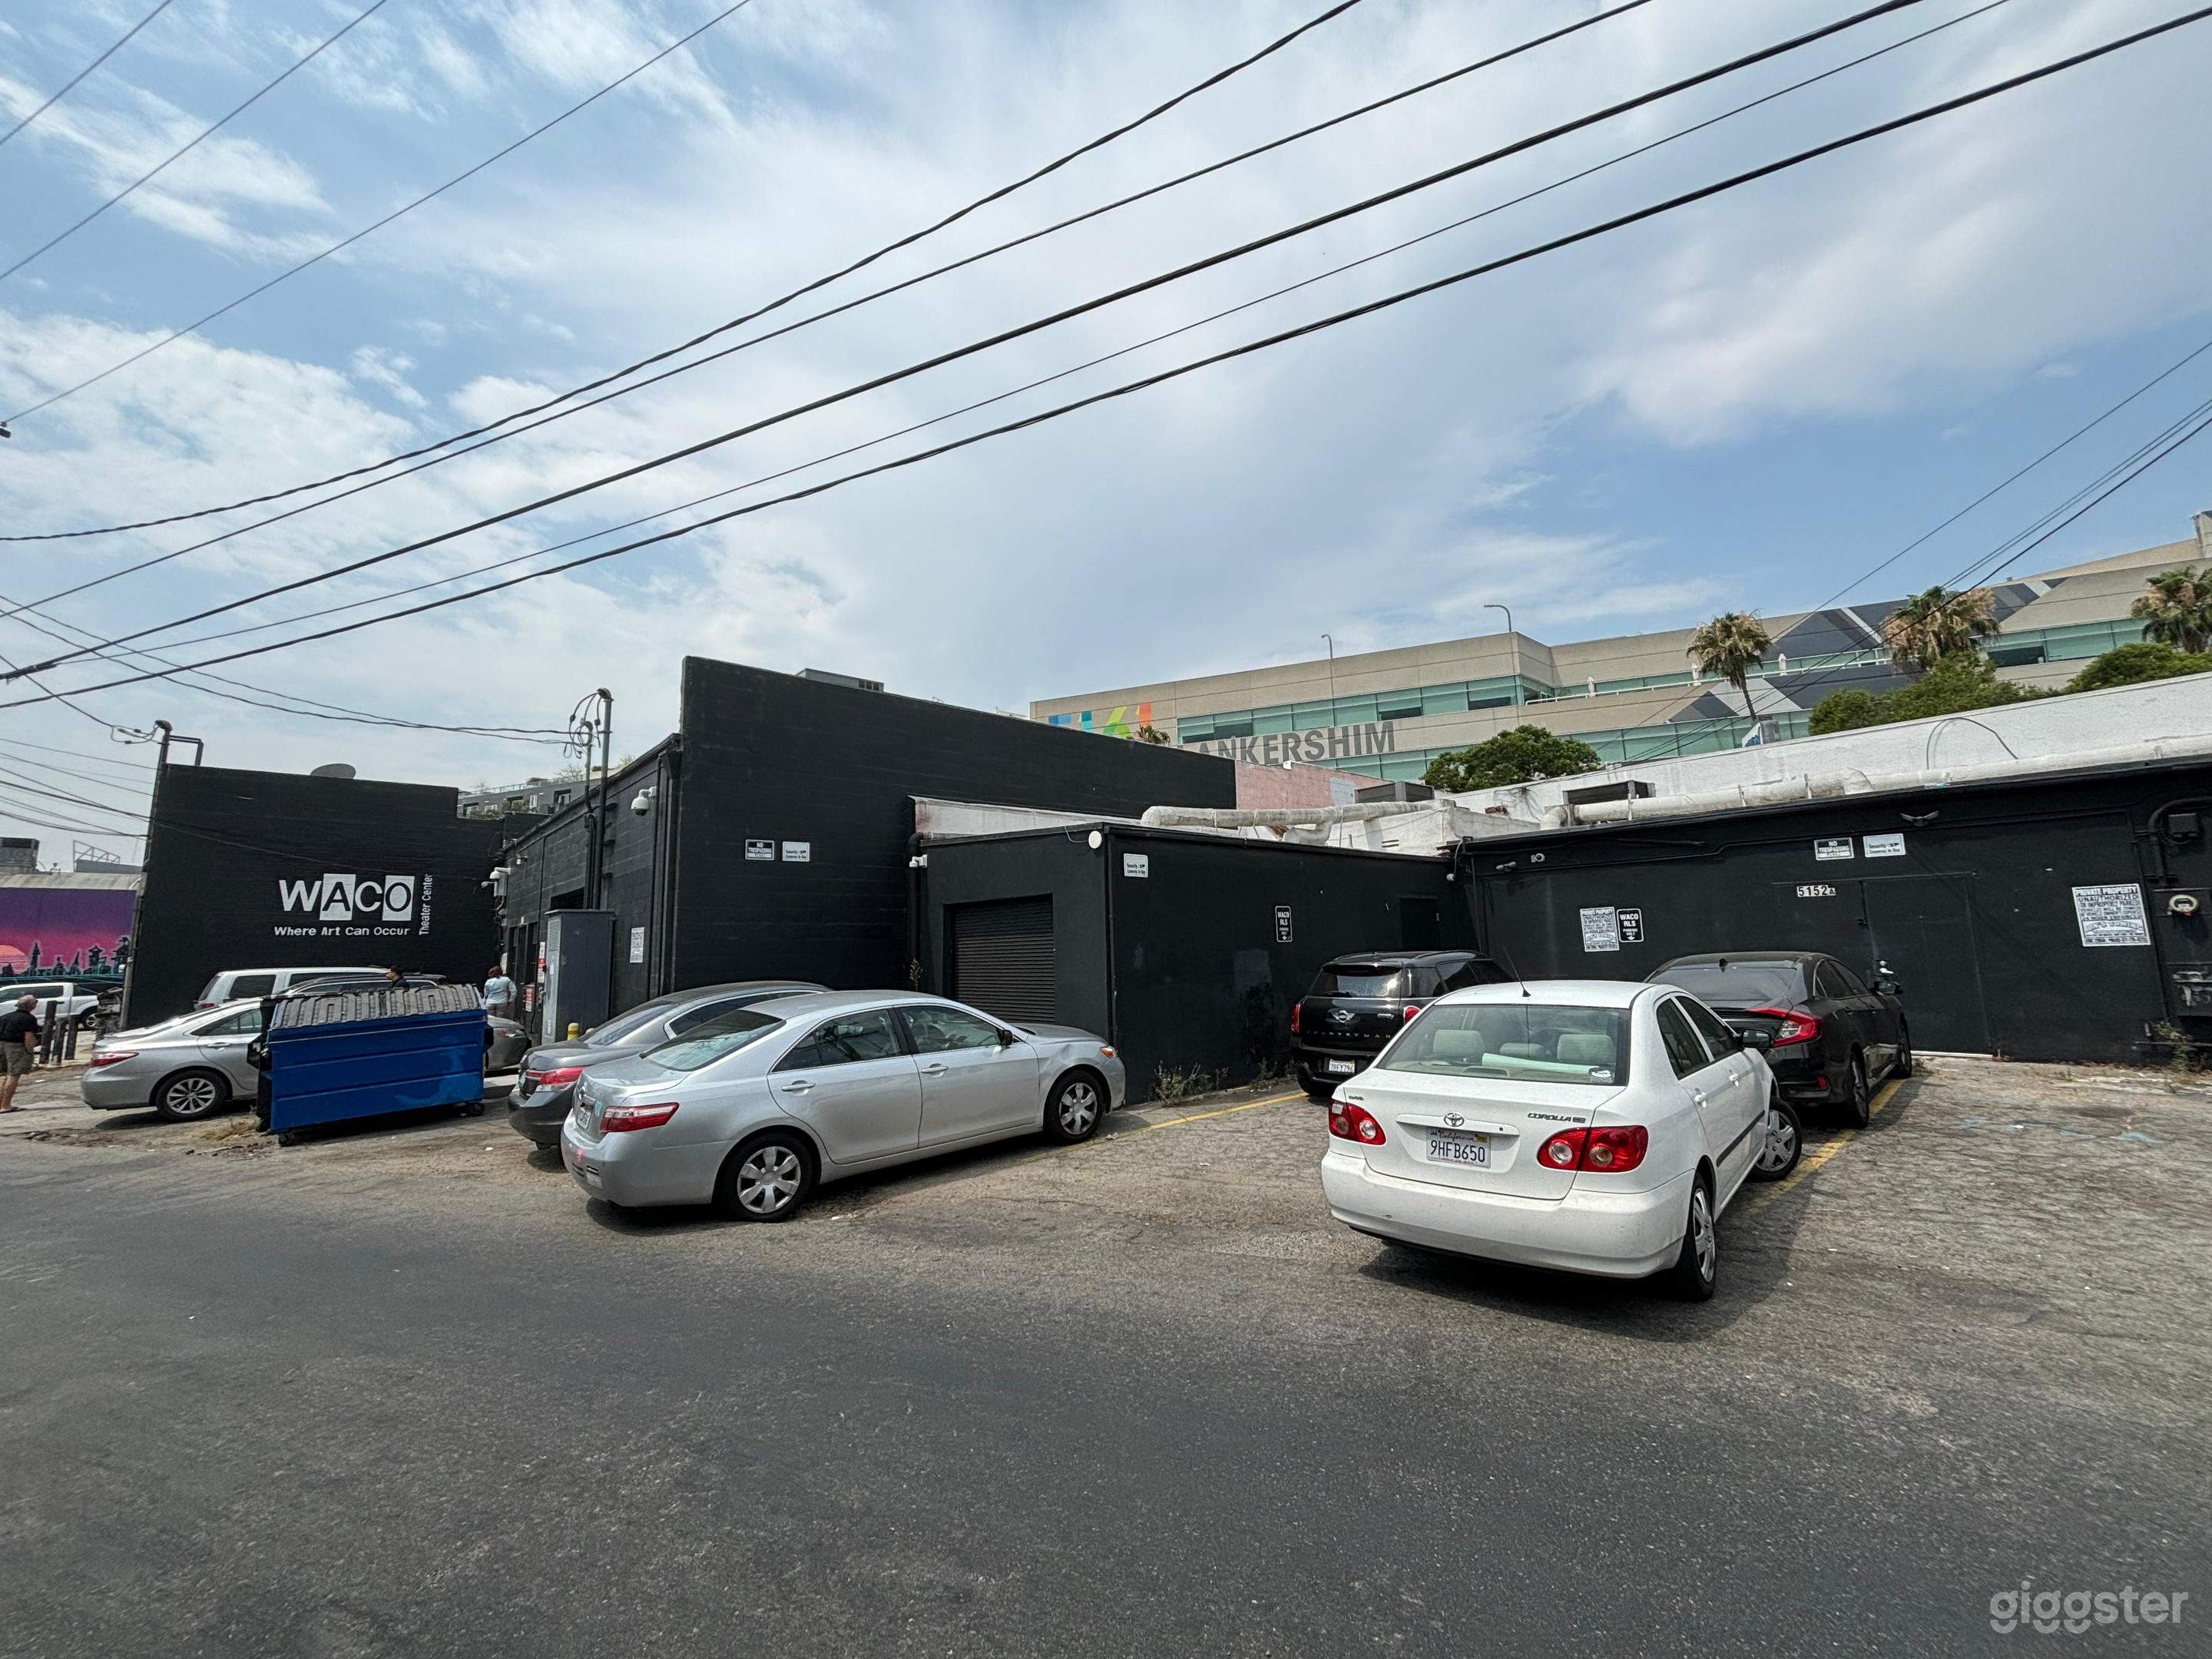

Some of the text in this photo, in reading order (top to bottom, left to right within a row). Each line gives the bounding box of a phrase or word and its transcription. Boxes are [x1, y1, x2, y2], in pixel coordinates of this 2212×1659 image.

[279, 879, 412, 914] WACO
[419, 873, 433, 935] Theater Center
[274, 926, 410, 936] Where Art Can Occur
[1306, 1030, 1391, 1038] COUNTRYMAN
[1528, 1113, 1571, 1122] COROLLA
[1439, 1130, 1477, 1142] California
[1430, 1140, 1485, 1163] 9HFB650
